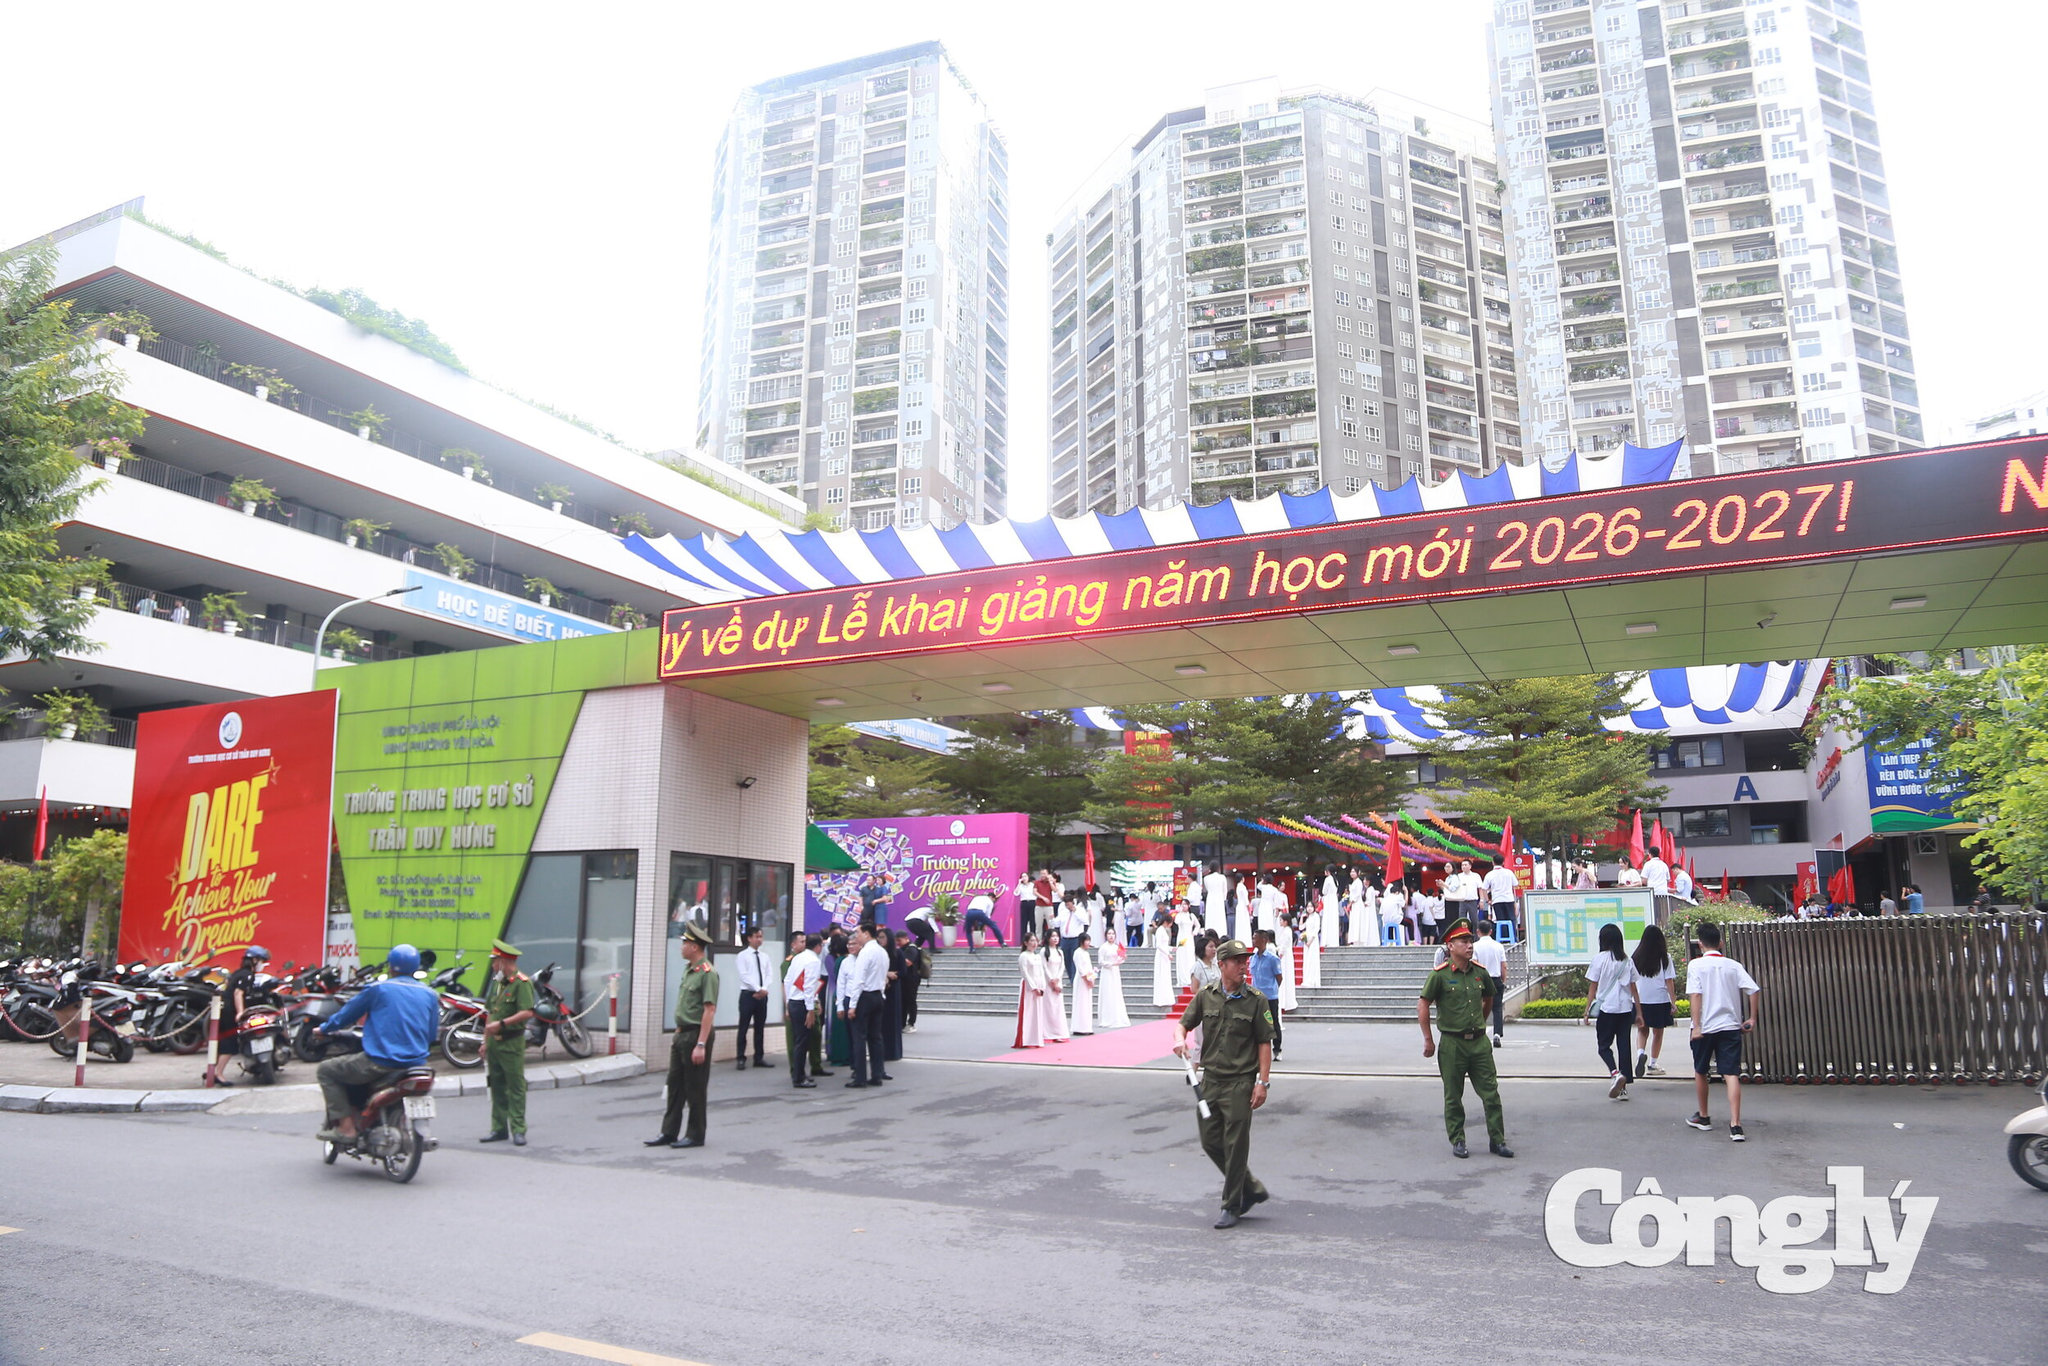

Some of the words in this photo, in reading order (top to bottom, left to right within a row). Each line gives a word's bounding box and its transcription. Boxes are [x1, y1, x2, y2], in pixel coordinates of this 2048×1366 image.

[702, 606, 743, 656] về
[752, 610, 809, 655] dự
[817, 591, 873, 644] Lễ
[978, 575, 1109, 636] giảng
[1122, 559, 1232, 610] năm
[1249, 550, 1347, 601] học
[1362, 525, 1475, 584] mới
[1489, 480, 1854, 571] 2026-2027!
[437, 590, 478, 617] HỌC
[483, 602, 512, 627] ĐỂ
[514, 614, 557, 640] BIẾT,
[1880, 753, 1898, 766] LÀM
[344, 784, 396, 814] TRƯỜNG
[402, 787, 446, 812] TRUNG
[453, 785, 482, 814] HỌC
[487, 780, 509, 807] CƠ
[512, 773, 534, 806] SỞ
[1733, 775, 1760, 801] A
[178, 774, 269, 884] DARE
[369, 818, 407, 851] TRẦN
[413, 826, 446, 849] DUY
[451, 821, 496, 849] HƯNG
[210, 863, 225, 887] to
[915, 854, 969, 874] Trường
[972, 853, 999, 872] học
[162, 882, 231, 931] Achieve
[229, 869, 276, 916] Your
[909, 871, 960, 900] Hạnh
[960, 870, 999, 898] phúc
[176, 911, 262, 962] Dreams
